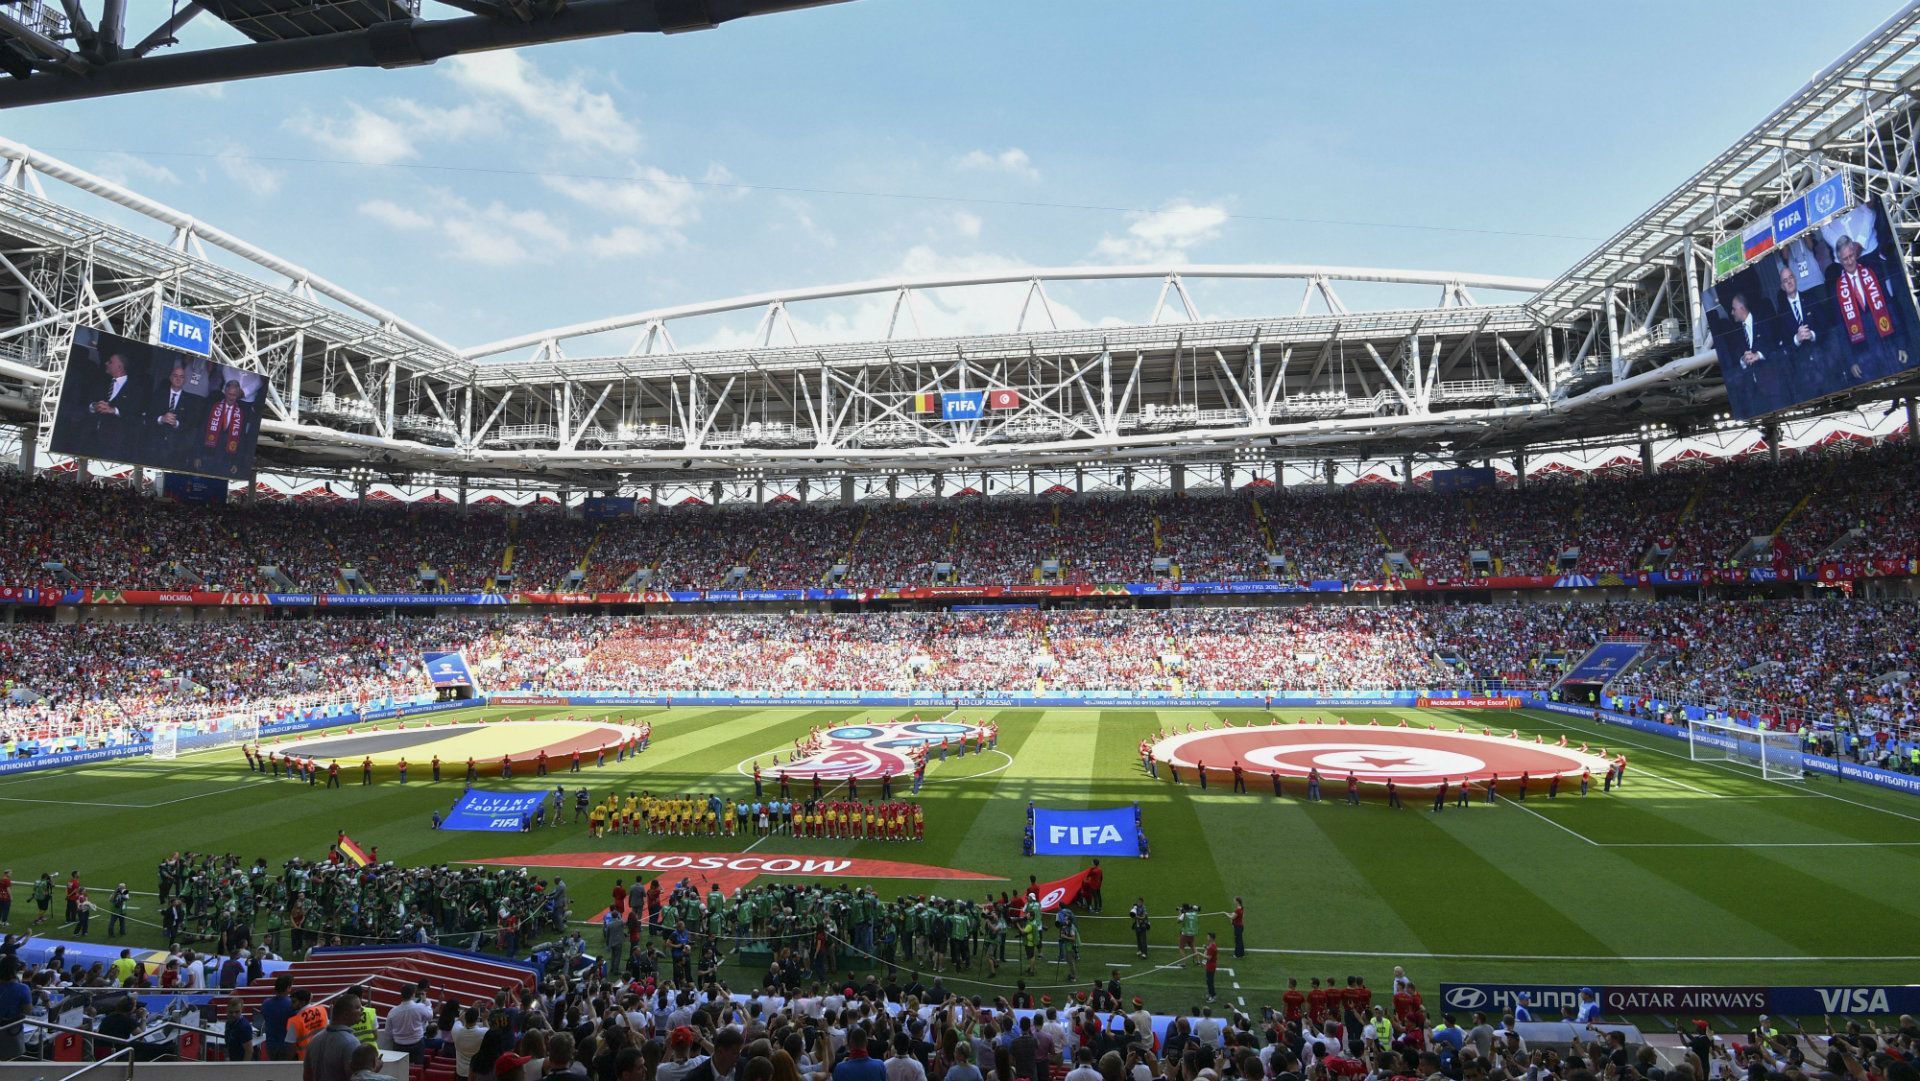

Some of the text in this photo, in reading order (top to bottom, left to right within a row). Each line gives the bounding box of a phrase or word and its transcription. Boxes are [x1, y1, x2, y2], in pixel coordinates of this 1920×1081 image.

[1778, 210, 1802, 232] FIFA
[168, 320, 202, 342] FIFA
[948, 400, 976, 412] FIFA
[74, 752, 106, 761] ФУТБОЛУ
[107, 748, 122, 757] FIFA
[1804, 758, 1920, 790] ЧЕМПИОНА МИРА ПО ФУТБОЛУ FIF
[471, 798, 536, 806] LIVING
[490, 818, 519, 828] FIFA
[1050, 824, 1122, 844] FIFA
[602, 854, 852, 872] MOSCOW
[1493, 990, 1600, 1008] HYUNDI
[1608, 992, 1765, 1010] QATAR AIRWAYS
[1814, 989, 1890, 1012] VISA
[301, 1008, 320, 1023] 234
[66, 1037, 72, 1047] 3
[186, 1037, 191, 1046] 2
